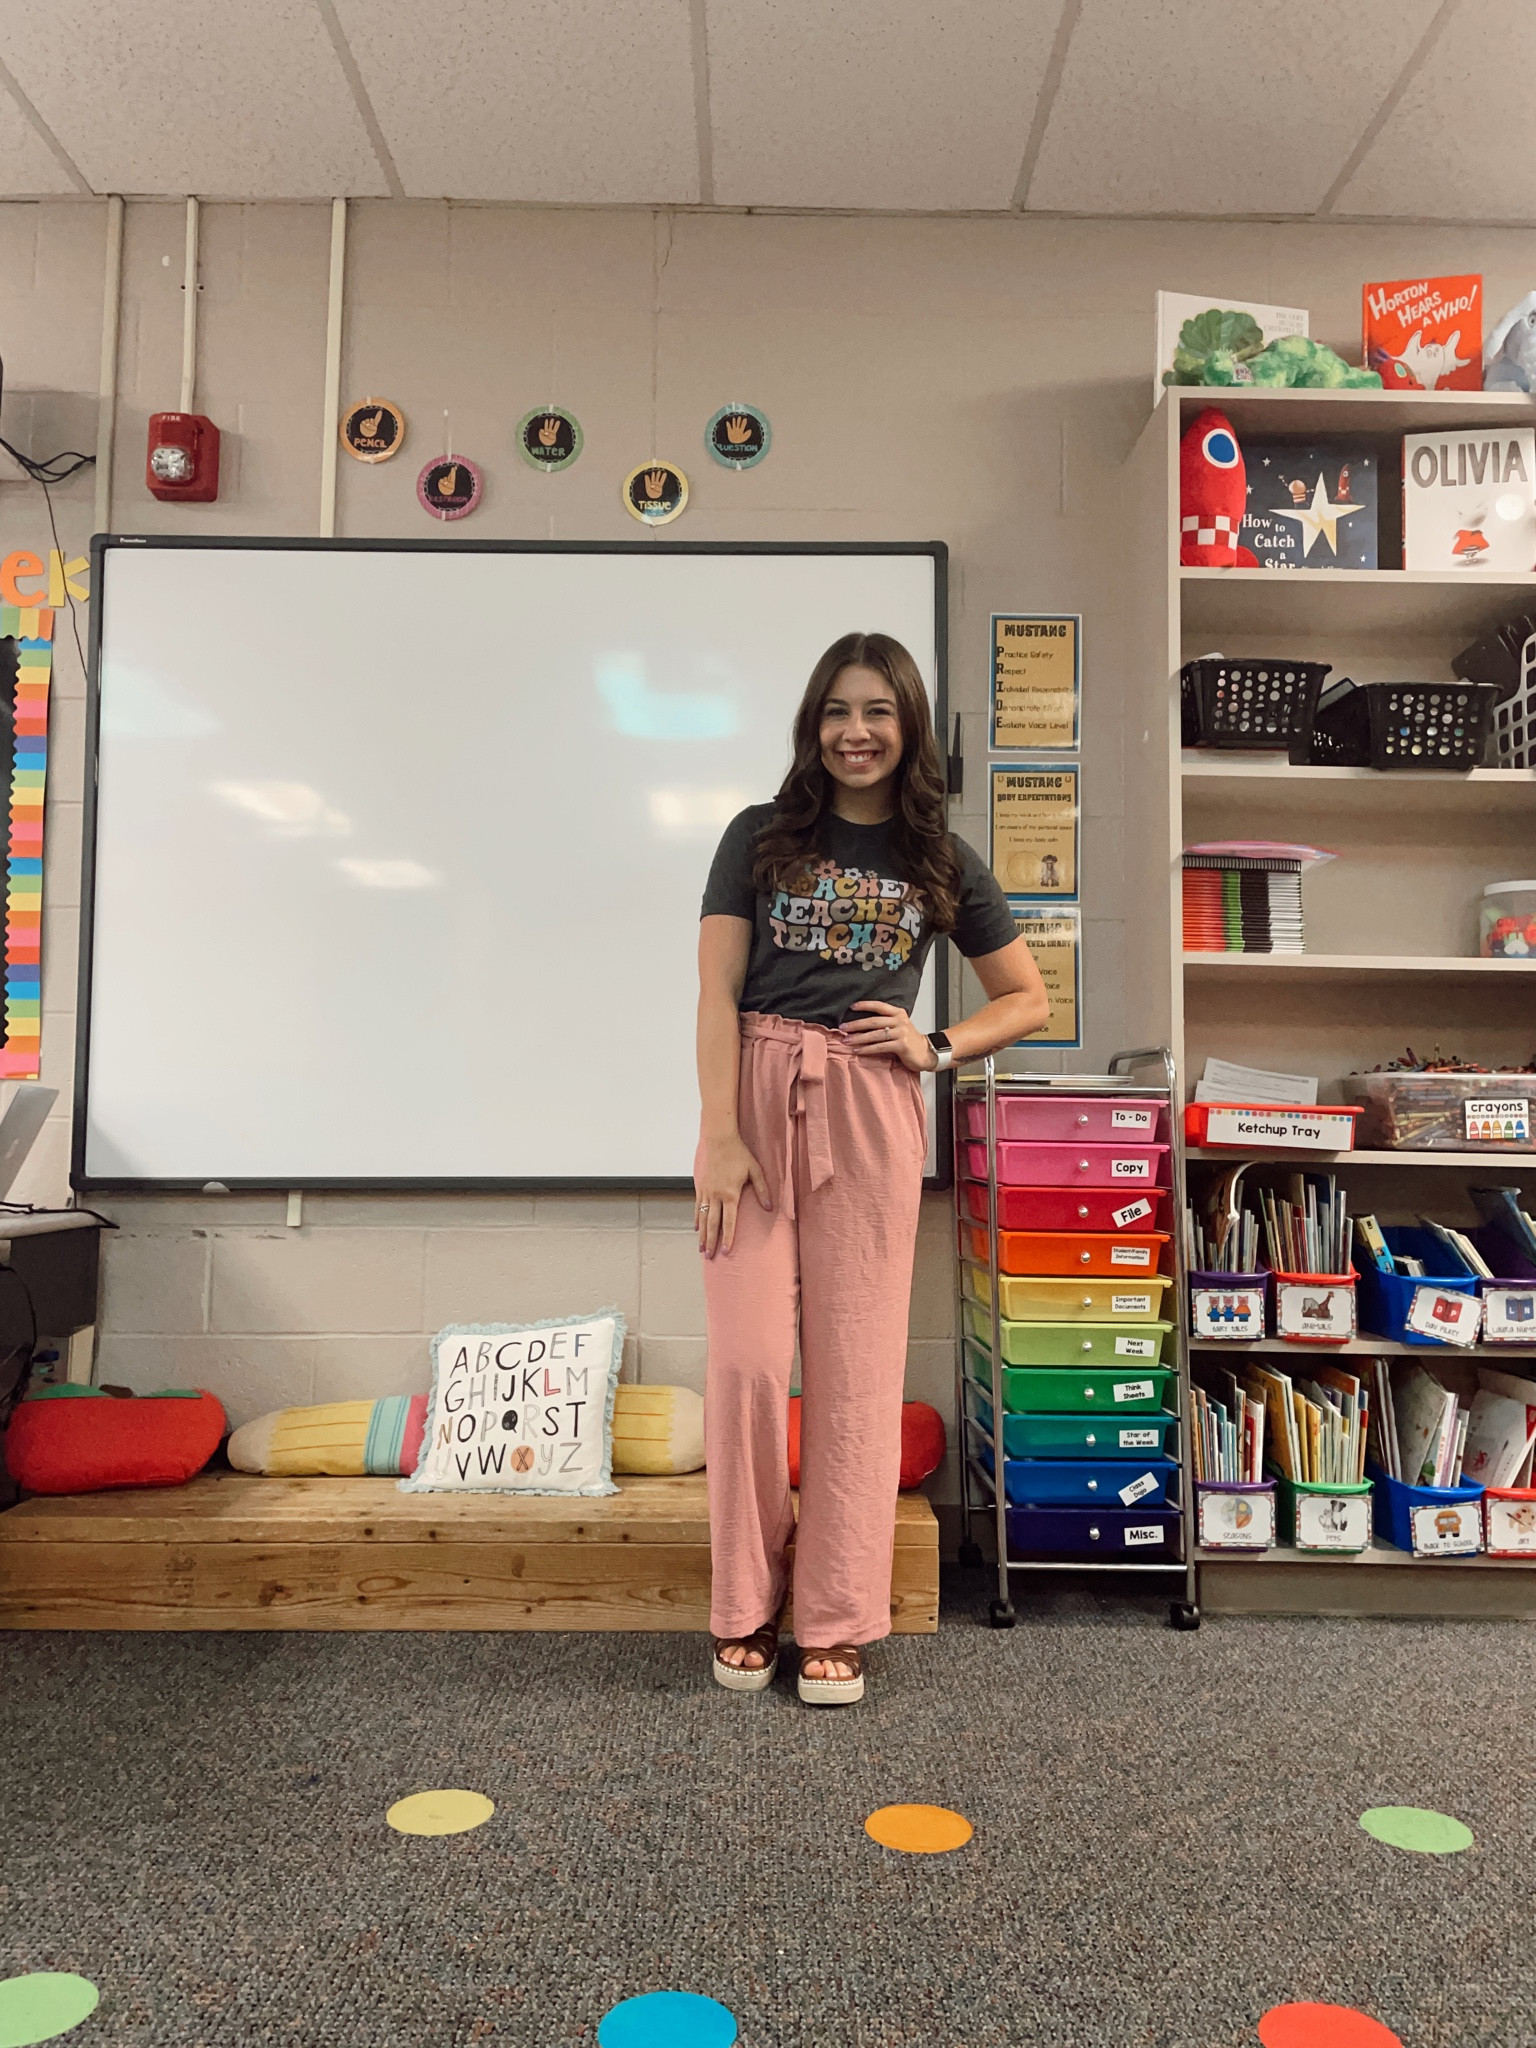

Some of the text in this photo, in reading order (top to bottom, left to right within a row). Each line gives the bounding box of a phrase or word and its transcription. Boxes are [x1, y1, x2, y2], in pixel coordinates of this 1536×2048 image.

[1368, 282, 1428, 320] HORTON
[1423, 284, 1478, 328] A WHO!
[1396, 291, 1442, 328] HEARS
[1411, 440, 1528, 488] OLIVIA
[1242, 514, 1272, 528] How
[1275, 523, 1286, 532] to
[1254, 533, 1295, 548] Catch
[1280, 552, 1286, 560] a
[1265, 558, 1296, 569] Star
[1004, 624, 1067, 637] MUSTANG
[1029, 721, 1047, 729] Voice
[1050, 721, 1069, 729] Level
[1006, 776, 1063, 788] MUSTANG
[1018, 793, 1072, 803] EXPECTATIONS
[770, 892, 922, 939] TEACHER
[769, 917, 913, 962] TEACHER
[1470, 1101, 1524, 1115] crayons
[1115, 1113, 1126, 1121] To
[1135, 1114, 1148, 1122] Do
[1237, 1122, 1321, 1140] Ketchup Tray
[1115, 1163, 1144, 1174] Copy
[1120, 1206, 1142, 1222] File
[1436, 1305, 1443, 1314] D
[1509, 1306, 1530, 1314] L N
[1123, 1391, 1146, 1399] Sheets
[1129, 1480, 1145, 1492] Class
[1129, 1530, 1158, 1540] Misc.
